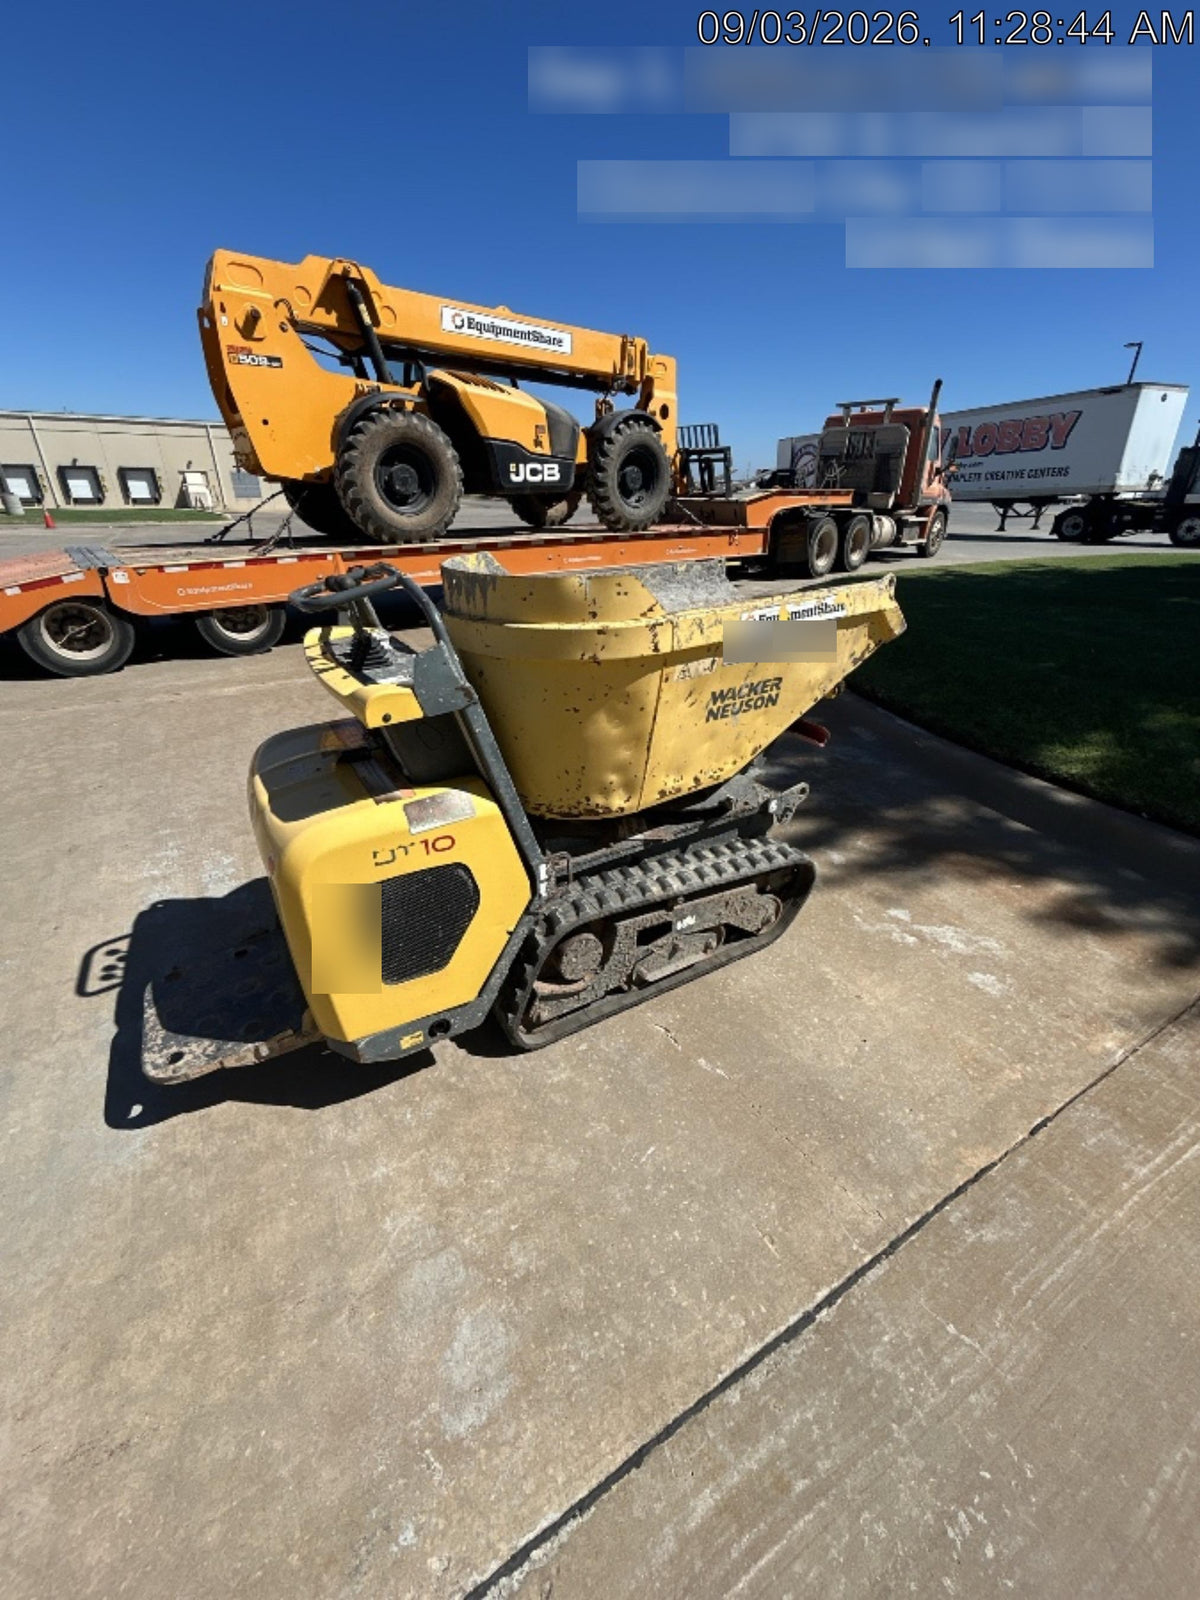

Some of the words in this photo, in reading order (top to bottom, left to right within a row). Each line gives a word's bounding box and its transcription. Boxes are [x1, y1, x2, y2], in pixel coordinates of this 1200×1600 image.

[466, 316, 564, 347] EquipmentShare
[956, 411, 1082, 457] LOBBY
[510, 463, 561, 483] JCB
[1027, 465, 1070, 478] CENTERS
[709, 677, 783, 706] WACKER
[706, 694, 779, 723] NEUSON
